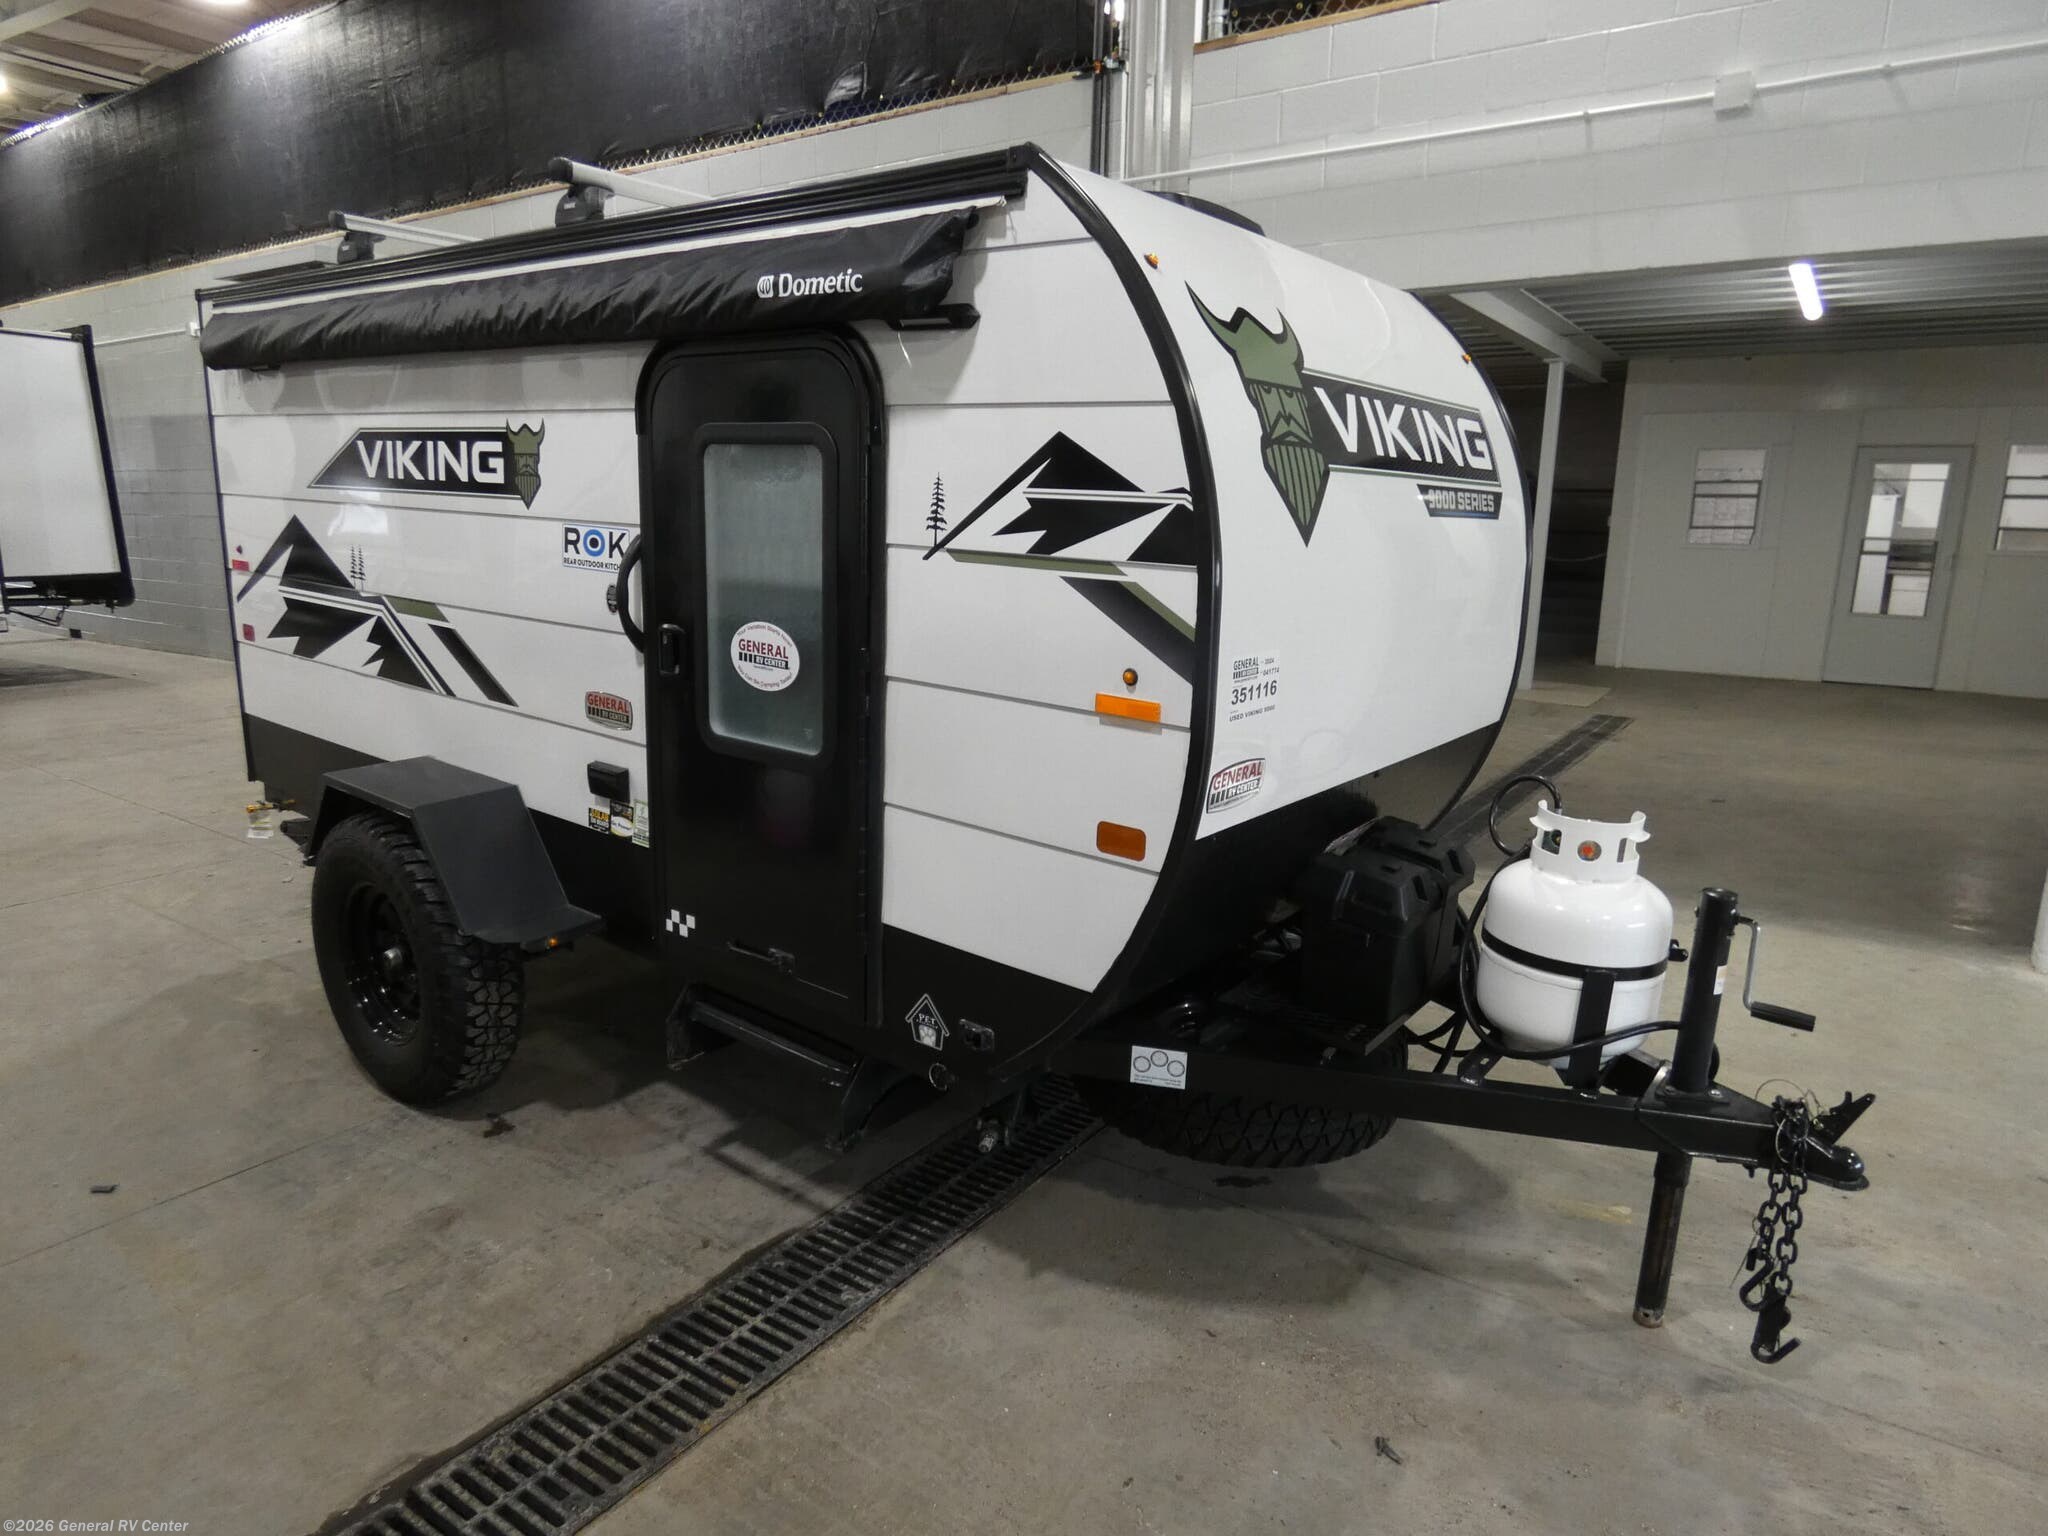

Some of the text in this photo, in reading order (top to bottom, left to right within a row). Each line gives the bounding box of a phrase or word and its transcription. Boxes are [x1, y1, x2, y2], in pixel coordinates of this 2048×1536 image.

[778, 268, 863, 298] Dometic
[1313, 386, 1493, 470] VIKING
[356, 440, 505, 484] VIKING
[1457, 492, 1495, 512] SERIES
[564, 527, 627, 558] ROK
[577, 559, 604, 568] OUTDOOR
[604, 562, 620, 571] KITCH
[738, 639, 788, 659] GENERAL
[764, 657, 786, 668] CENTER
[1233, 656, 1259, 671] GENERAL
[588, 694, 629, 713] GENERAL
[1231, 680, 1277, 705] 351116
[1213, 762, 1263, 790] GENERAL
